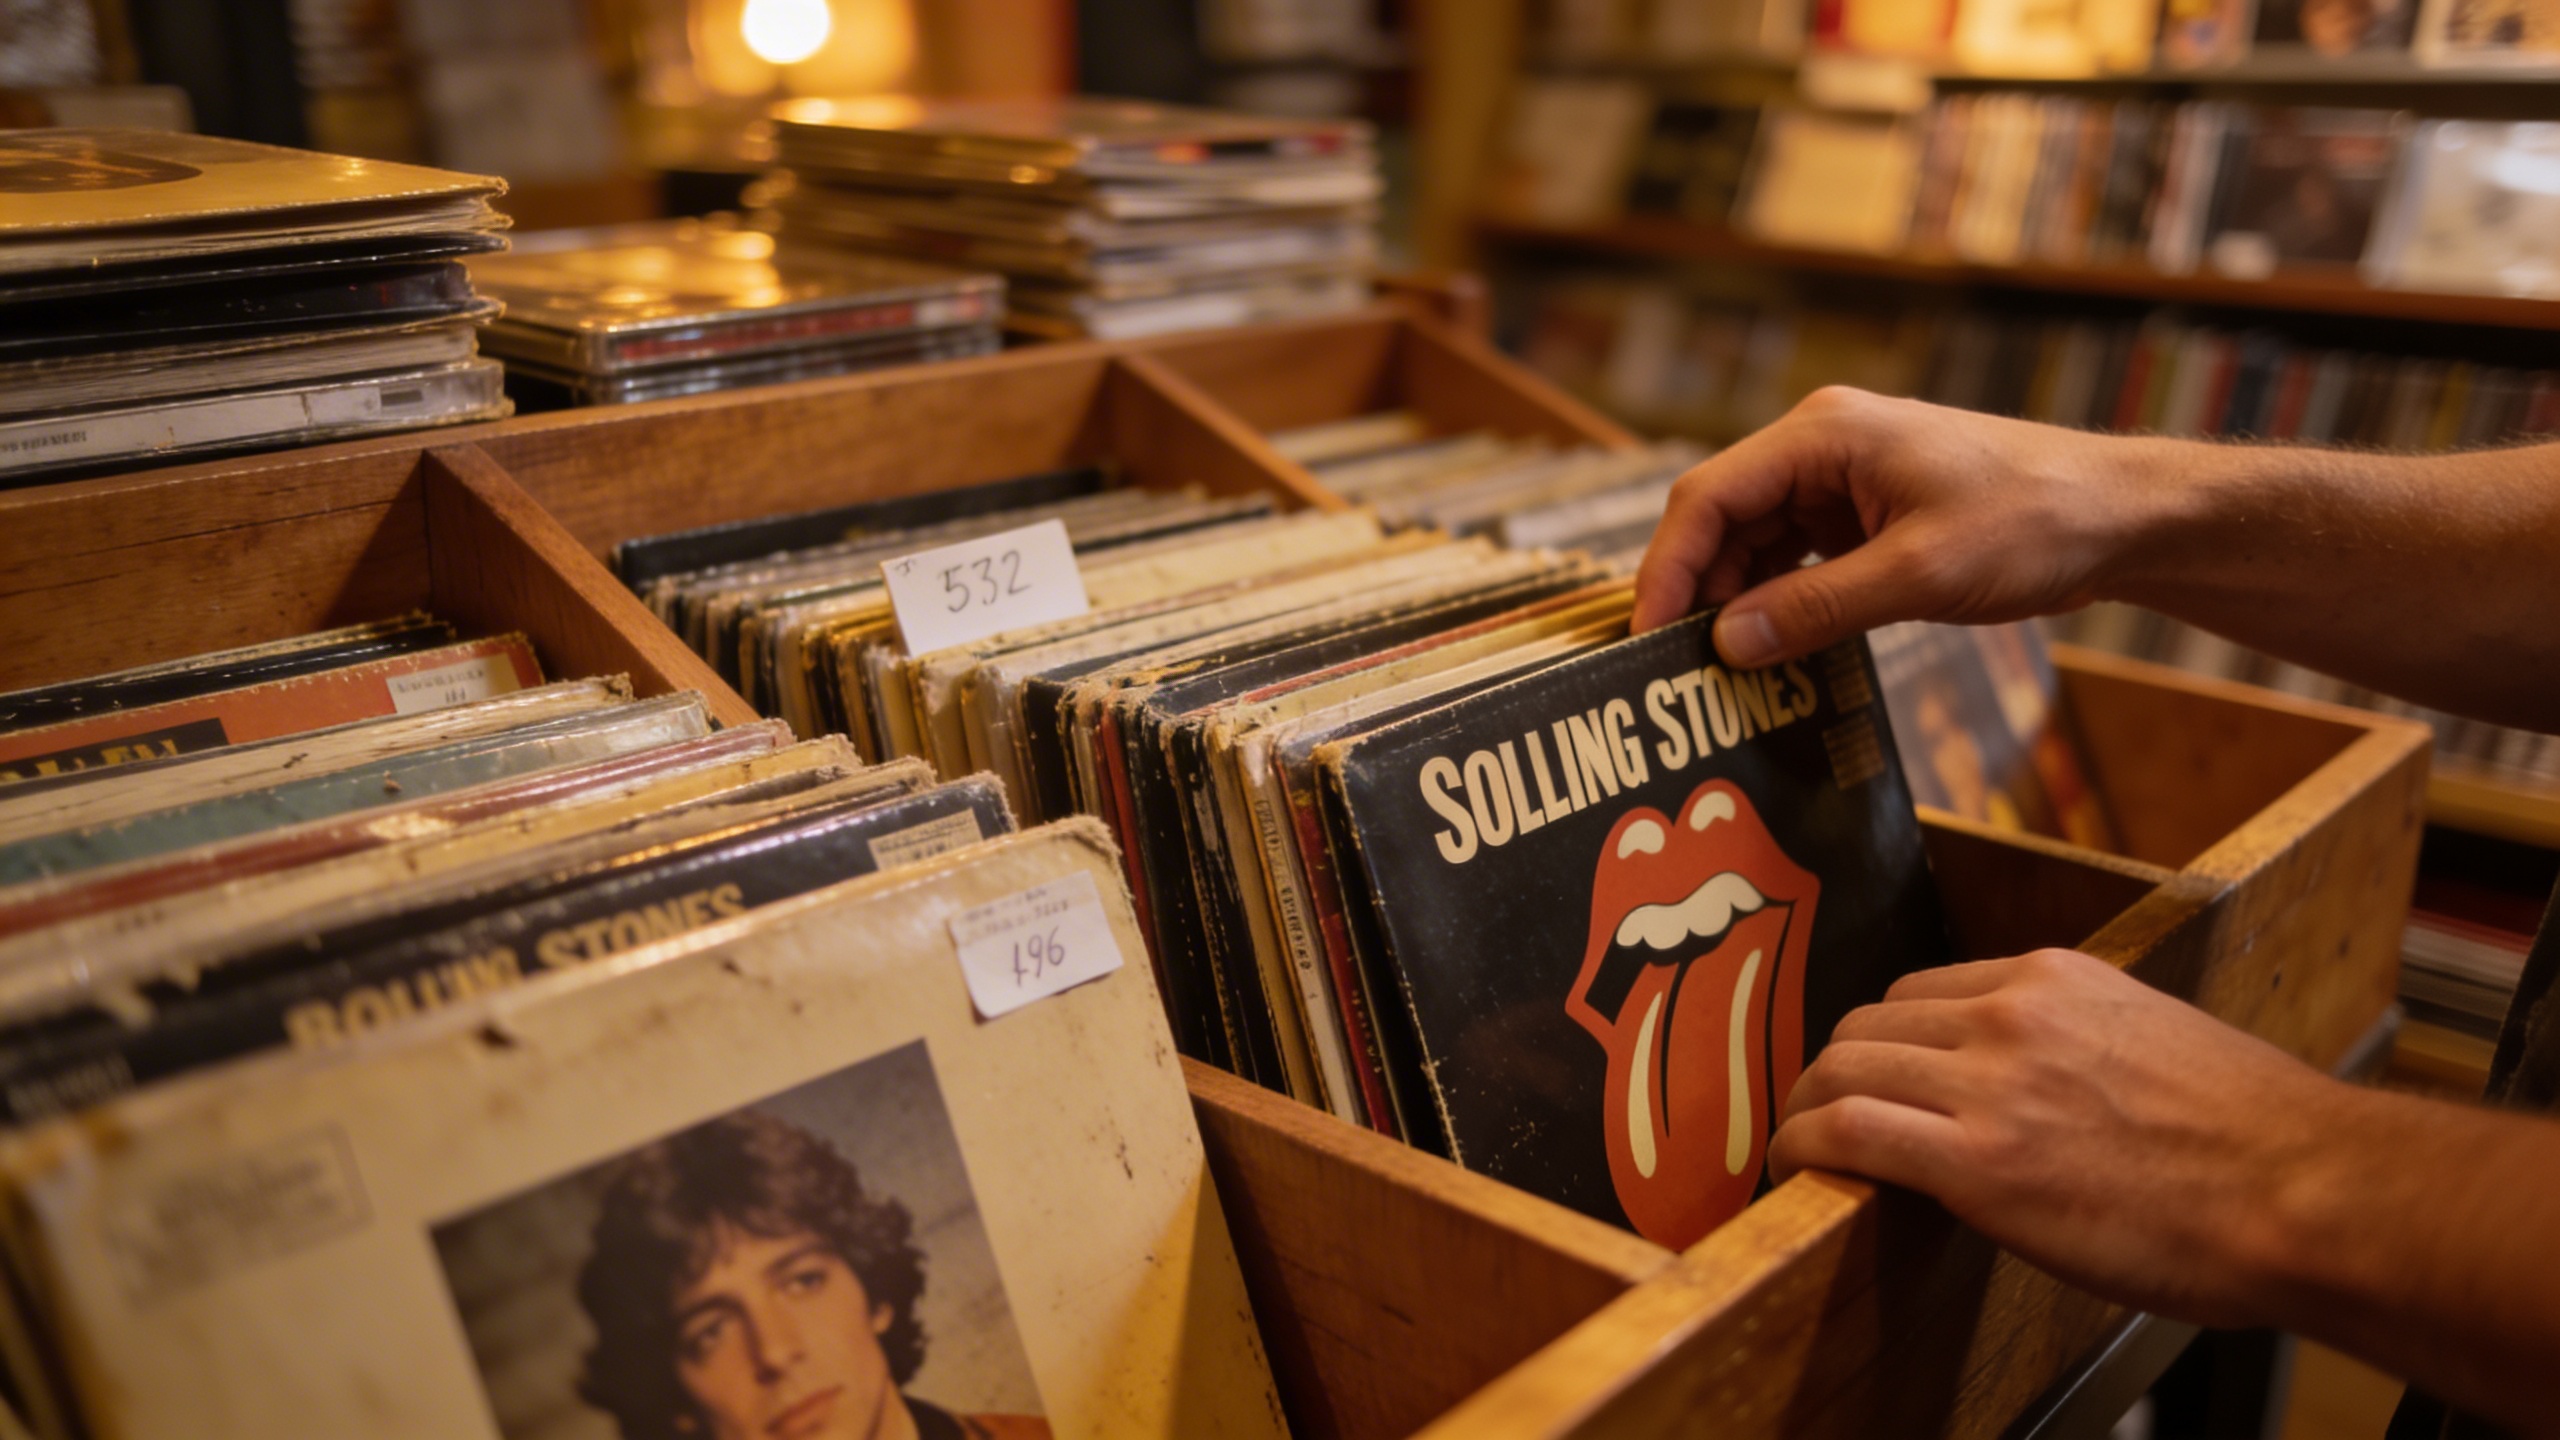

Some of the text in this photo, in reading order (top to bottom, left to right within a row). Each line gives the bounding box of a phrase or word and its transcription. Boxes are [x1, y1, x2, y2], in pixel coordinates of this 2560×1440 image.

[940, 549, 1032, 614] 532
[1419, 698, 1650, 865] SOLLING
[1645, 656, 1819, 771] STONES
